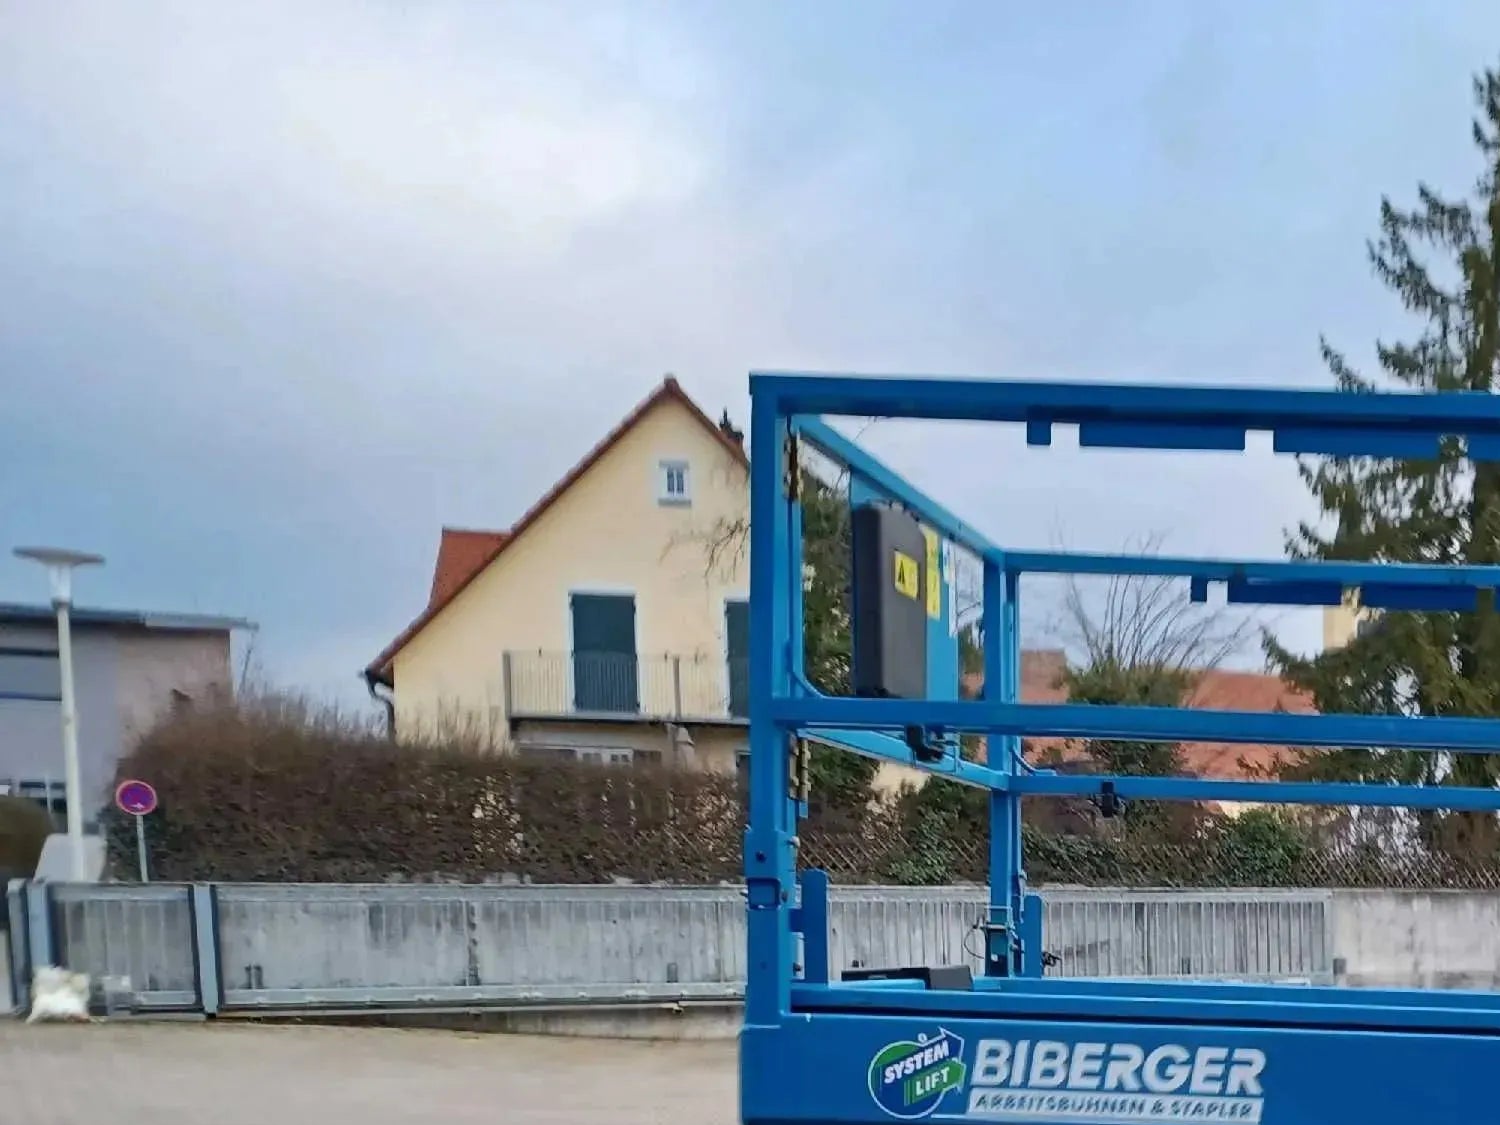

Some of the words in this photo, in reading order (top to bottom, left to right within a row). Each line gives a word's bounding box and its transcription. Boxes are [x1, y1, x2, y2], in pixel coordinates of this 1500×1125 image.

[884, 1040, 950, 1084] SYSTEM
[970, 1039, 1267, 1095] BIBERGER
[916, 1067, 950, 1096] LIFT
[1151, 1100, 1164, 1114] &
[1170, 1101, 1252, 1118] STAPLER
